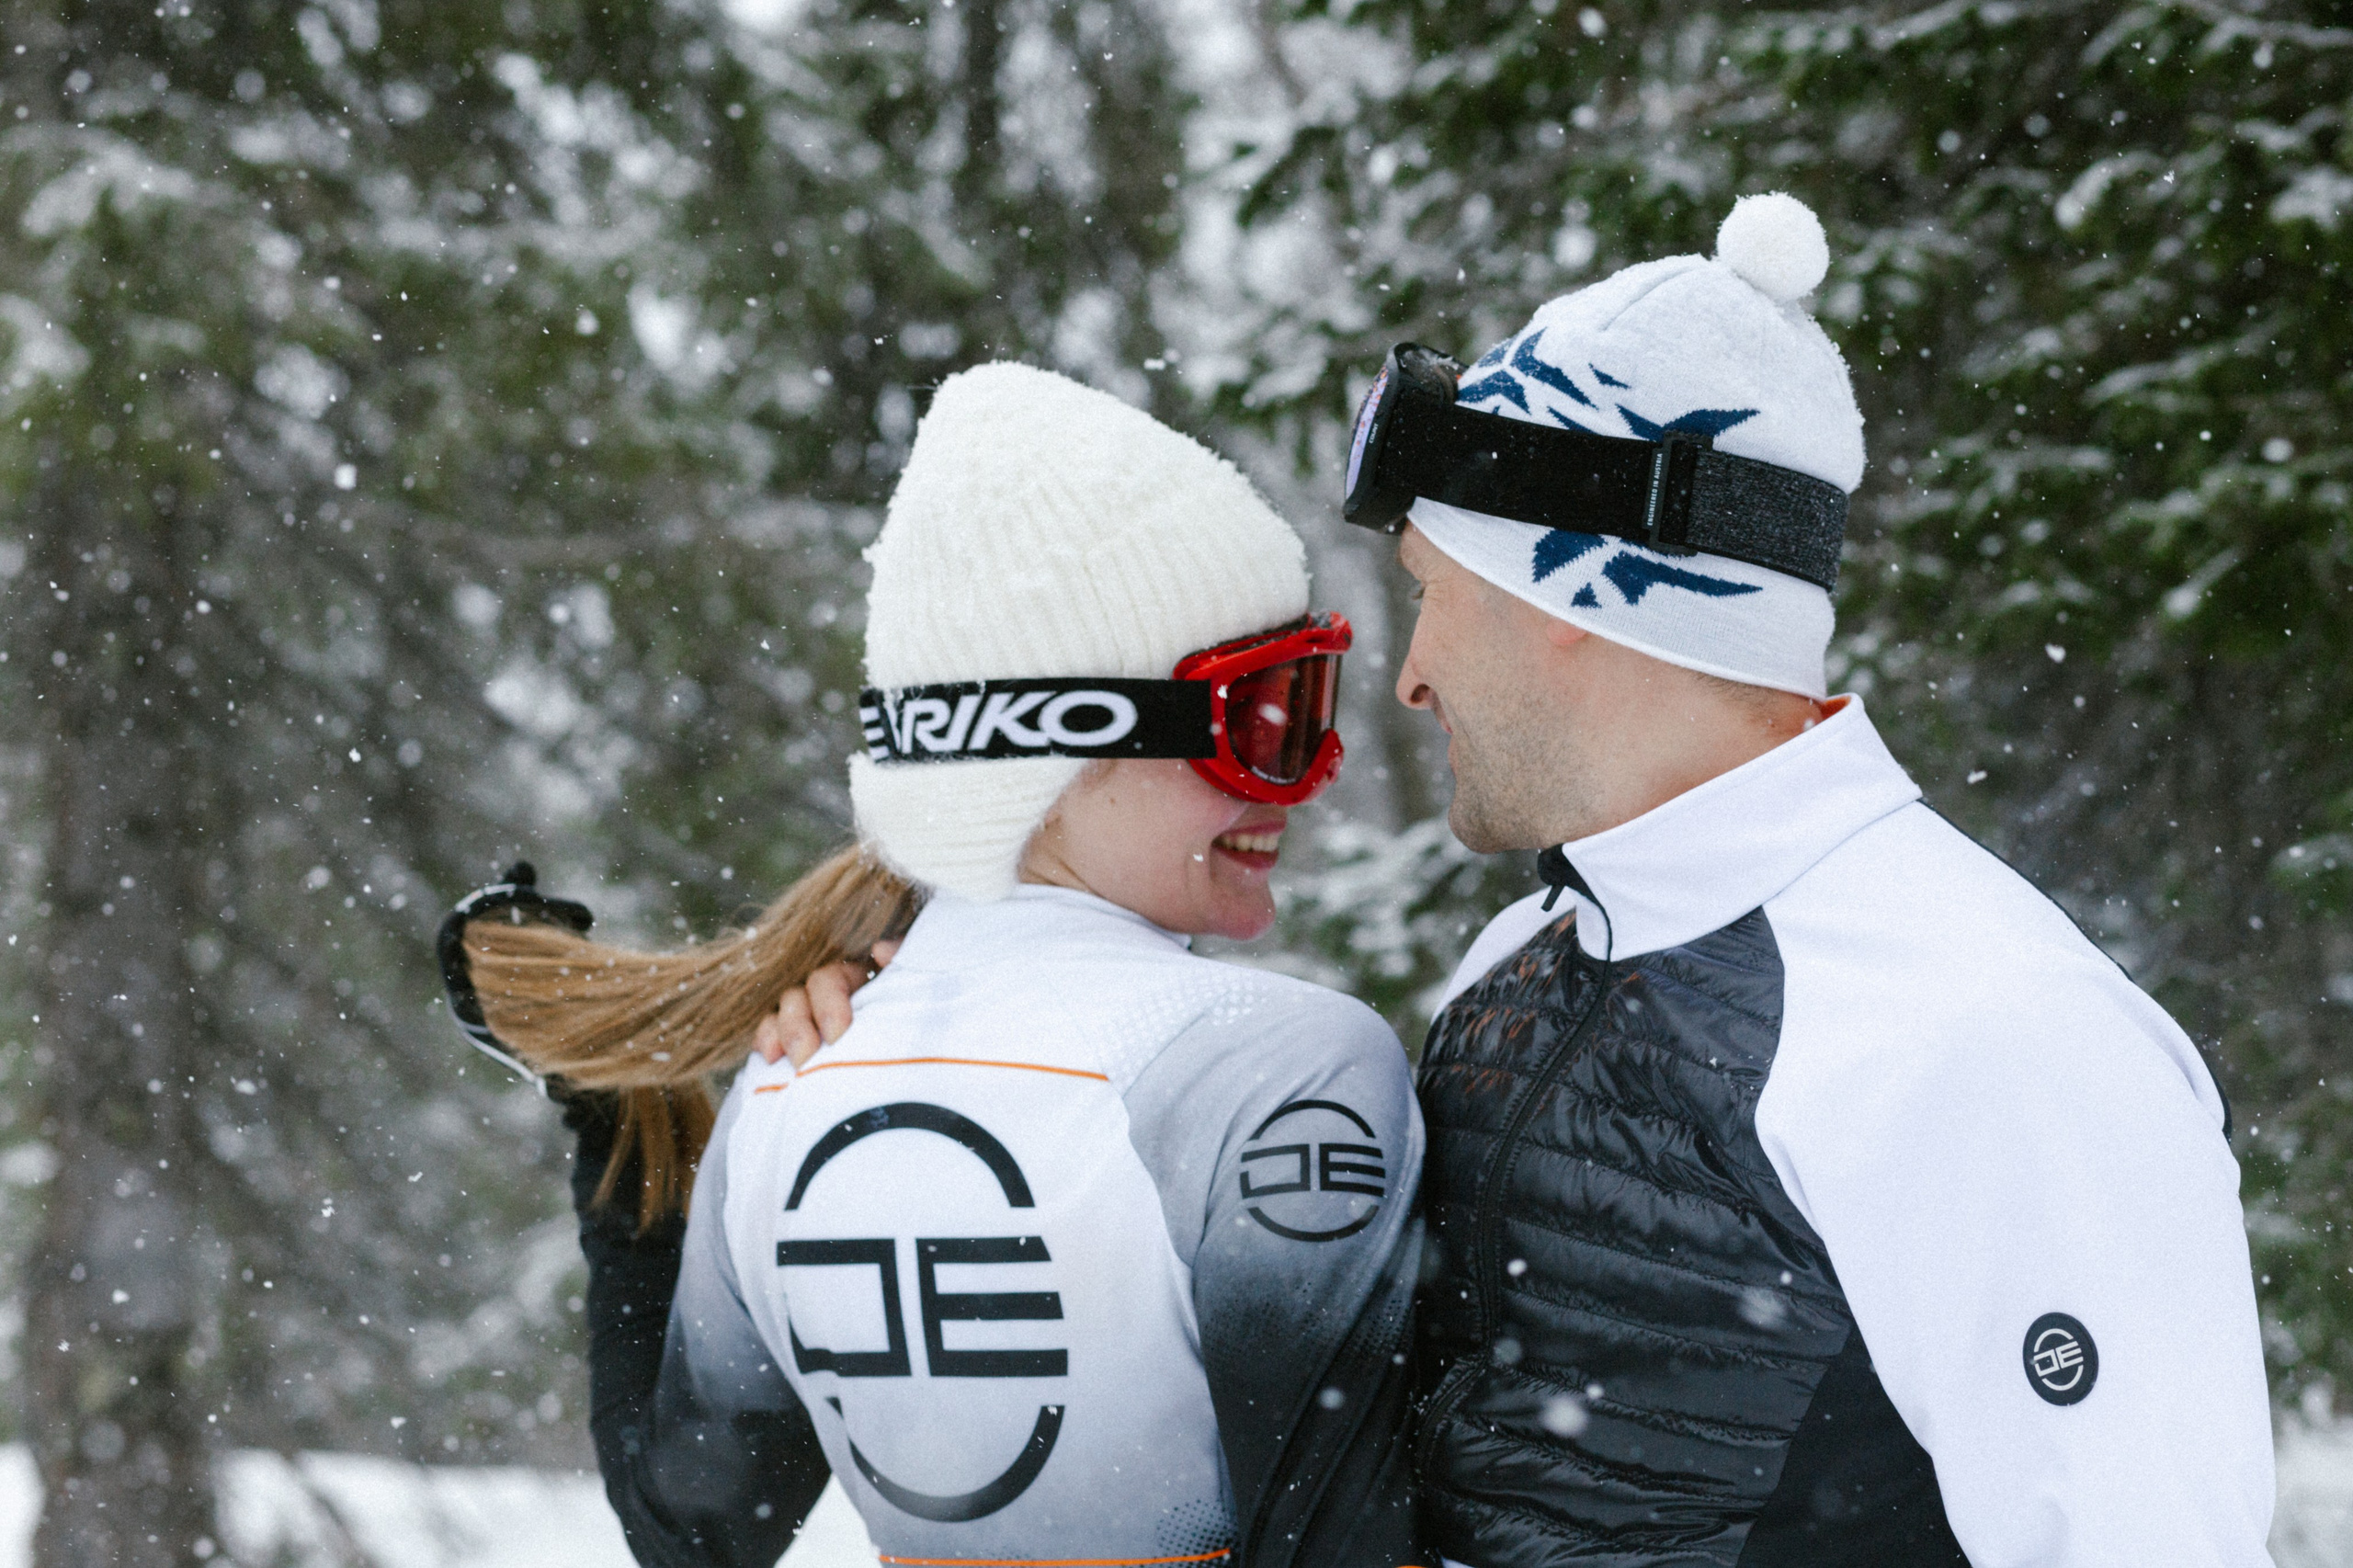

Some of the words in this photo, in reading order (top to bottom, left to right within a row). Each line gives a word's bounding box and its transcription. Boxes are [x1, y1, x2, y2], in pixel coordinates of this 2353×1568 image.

[1654, 453, 1663, 479] AUSTRIA
[1653, 480, 1659, 488] IN
[1647, 488, 1658, 526] ENGINEERED
